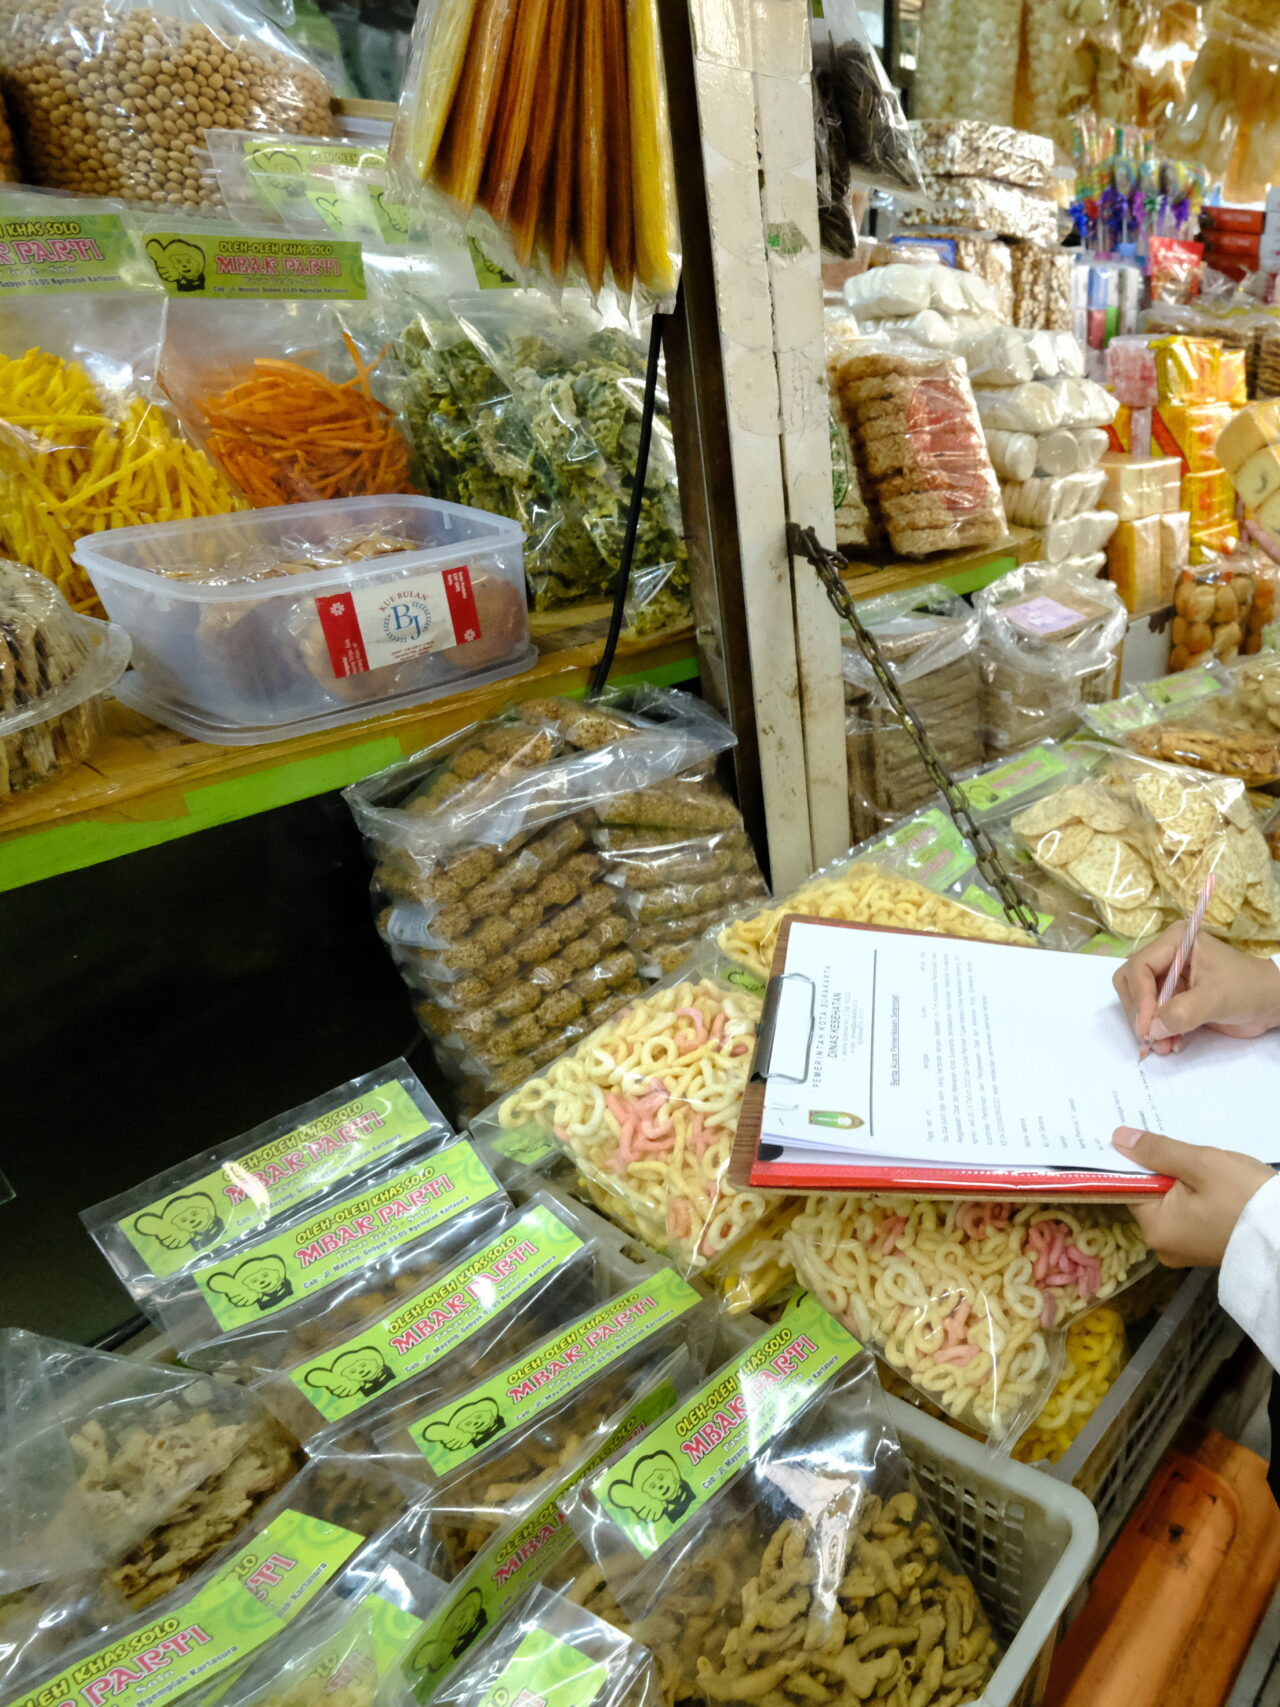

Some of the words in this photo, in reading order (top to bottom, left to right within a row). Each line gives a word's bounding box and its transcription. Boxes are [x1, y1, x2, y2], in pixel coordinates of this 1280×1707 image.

[6, 221, 45, 237] KHAS
[47, 221, 82, 235] SOLO
[12, 238, 104, 264] PARTI
[219, 241, 280, 254] OLEH-OLEH
[282, 244, 308, 256] KHAS
[309, 245, 333, 256] SOLO
[215, 256, 280, 276] MBAK
[283, 257, 341, 277] PARTI
[379, 597, 396, 612] KUE
[397, 590, 429, 602] BULAN
[818, 1011, 827, 1031] KOTA
[830, 991, 842, 1033] KESEHATAN
[812, 1033, 825, 1089] PEMERINTAH
[827, 1034, 839, 1058] DINAS
[889, 1071, 898, 1087] Berita
[299, 1112, 332, 1144] KHAS
[331, 1102, 364, 1125] SOLO
[305, 1110, 385, 1162] PARTI
[295, 1214, 379, 1269] MBAK
[375, 1174, 454, 1226] PARTI
[296, 1202, 371, 1244] OLEH-OLEH
[371, 1183, 404, 1207] KHAS
[402, 1166, 435, 1189] SOLO
[389, 1281, 458, 1335] OLEH-OLEH
[457, 1260, 489, 1284] KHAS
[488, 1235, 517, 1264] SOLO
[390, 1293, 471, 1356] MBAK
[506, 1344, 587, 1404] MBAK
[584, 1296, 659, 1351] PARTI
[507, 1332, 577, 1385] OLEH-OLEH
[578, 1313, 609, 1337] KHAS
[609, 1293, 640, 1314] SOLO
[676, 1376, 738, 1437] OLEH-OLEH
[764, 1328, 792, 1356] SOLO
[681, 1394, 748, 1466] MBAK
[702, 1475, 717, 1489] Cab
[812, 1355, 839, 1379] Kartasura
[73, 1650, 129, 1686] KHAS
[130, 1617, 180, 1654] SOLO
[79, 1623, 214, 1707] PARTI
[190, 1645, 239, 1679] Kartasura
[134, 1669, 175, 1696] Solo
